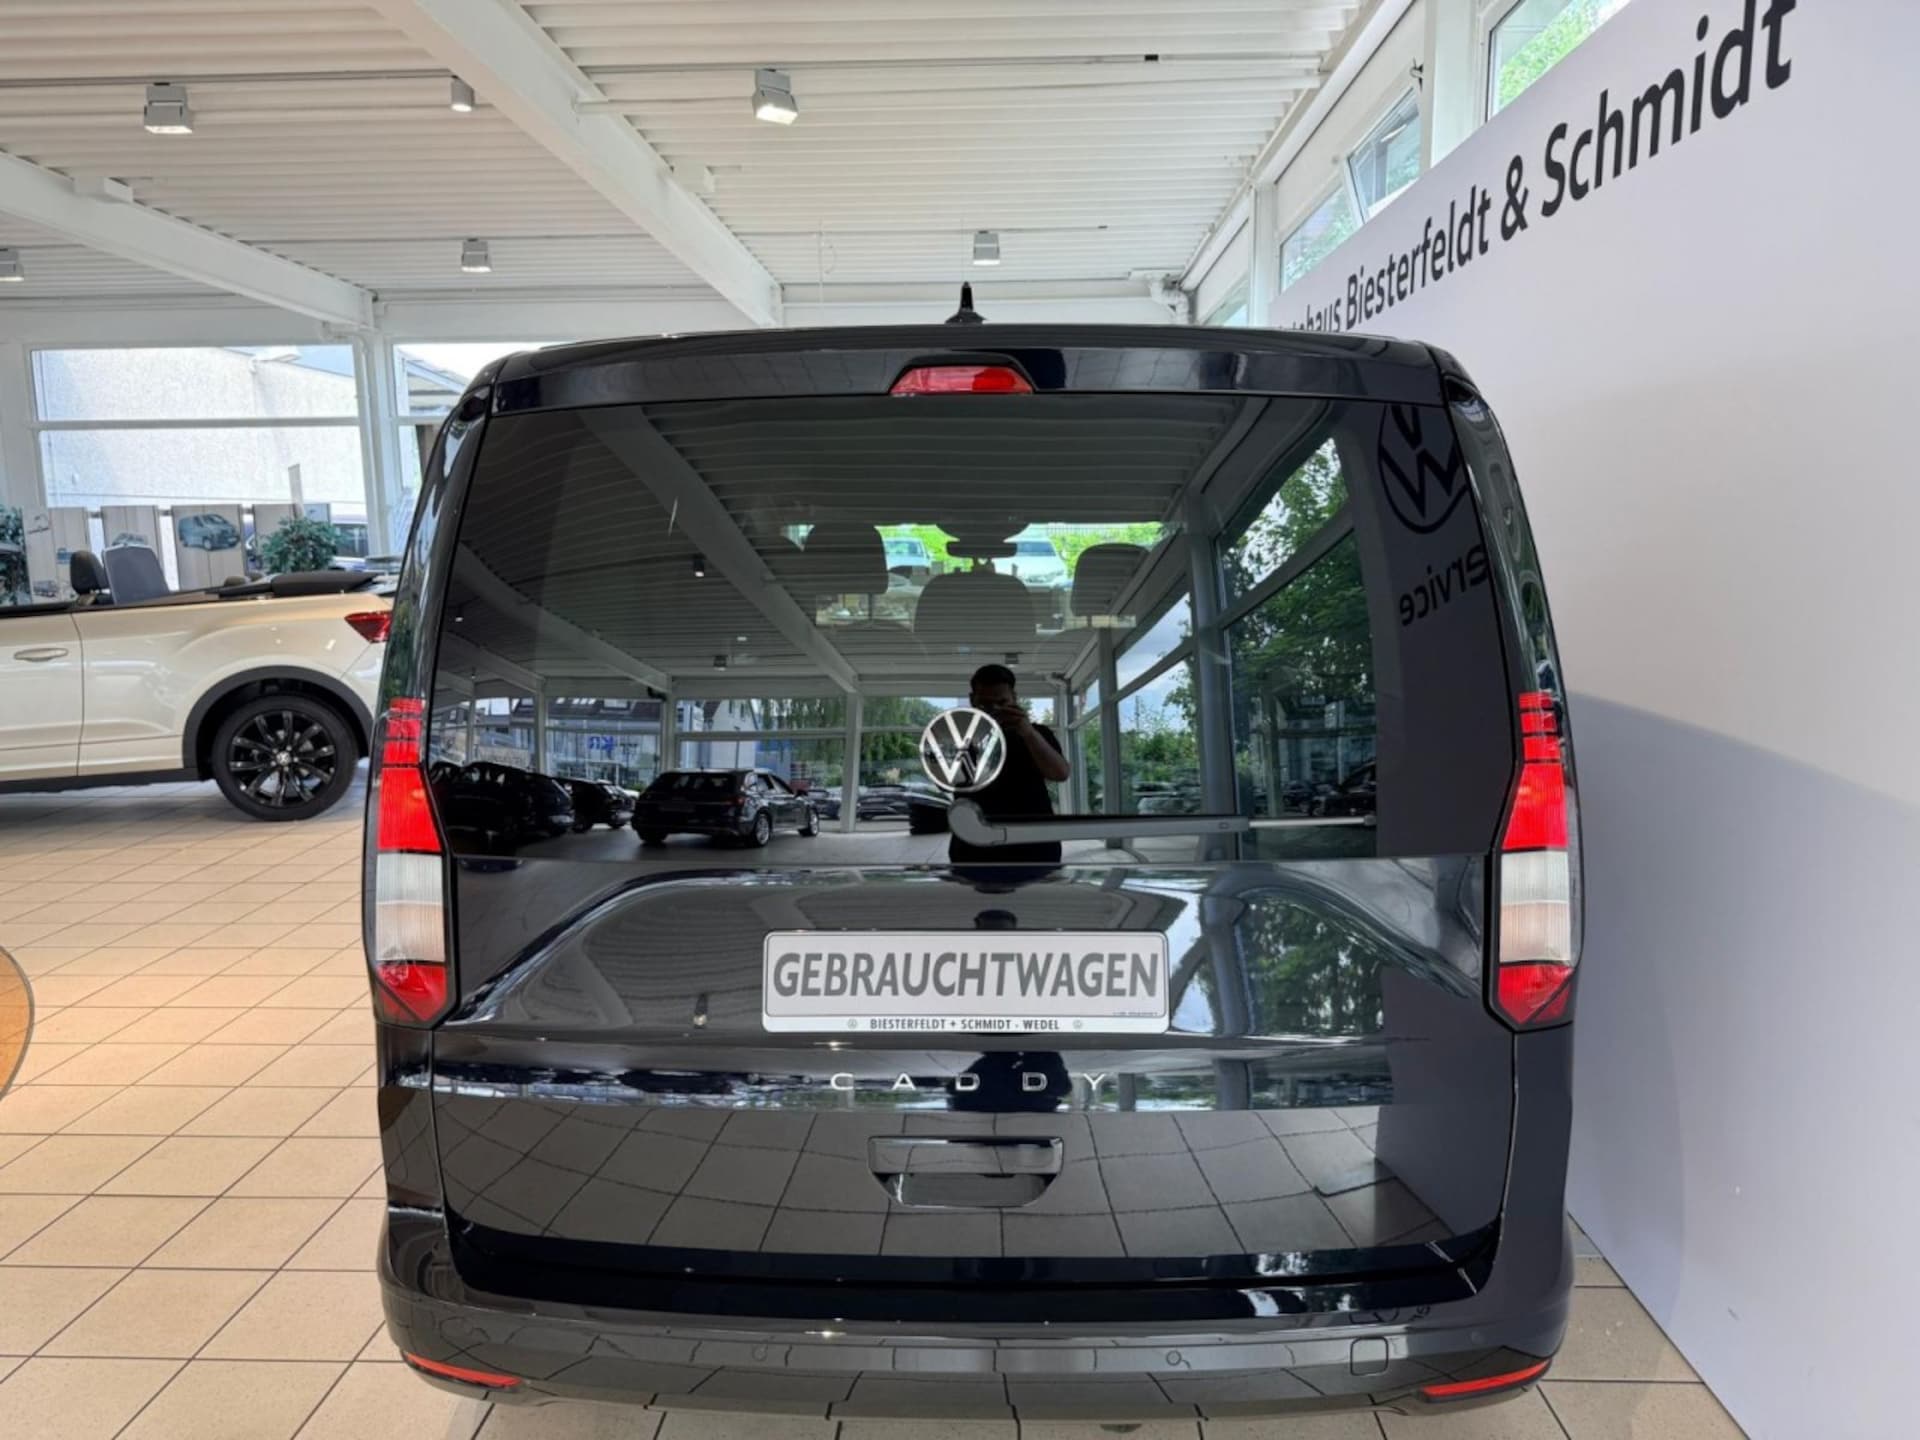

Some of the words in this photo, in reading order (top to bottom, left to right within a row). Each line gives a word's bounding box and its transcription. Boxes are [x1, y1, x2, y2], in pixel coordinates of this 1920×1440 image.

[1346, 185, 1490, 330] Biesterfeldt
[1500, 155, 1528, 240] &
[1541, 0, 1797, 217] Schmidt
[773, 952, 1159, 998] GEBRAUCHTWAGEN
[870, 1018, 946, 1030] BIESTERFELDT
[961, 1018, 1011, 1030] SCHMIDT
[1023, 1018, 1060, 1030] WEDEL
[830, 1073, 1106, 1091] CADDY
